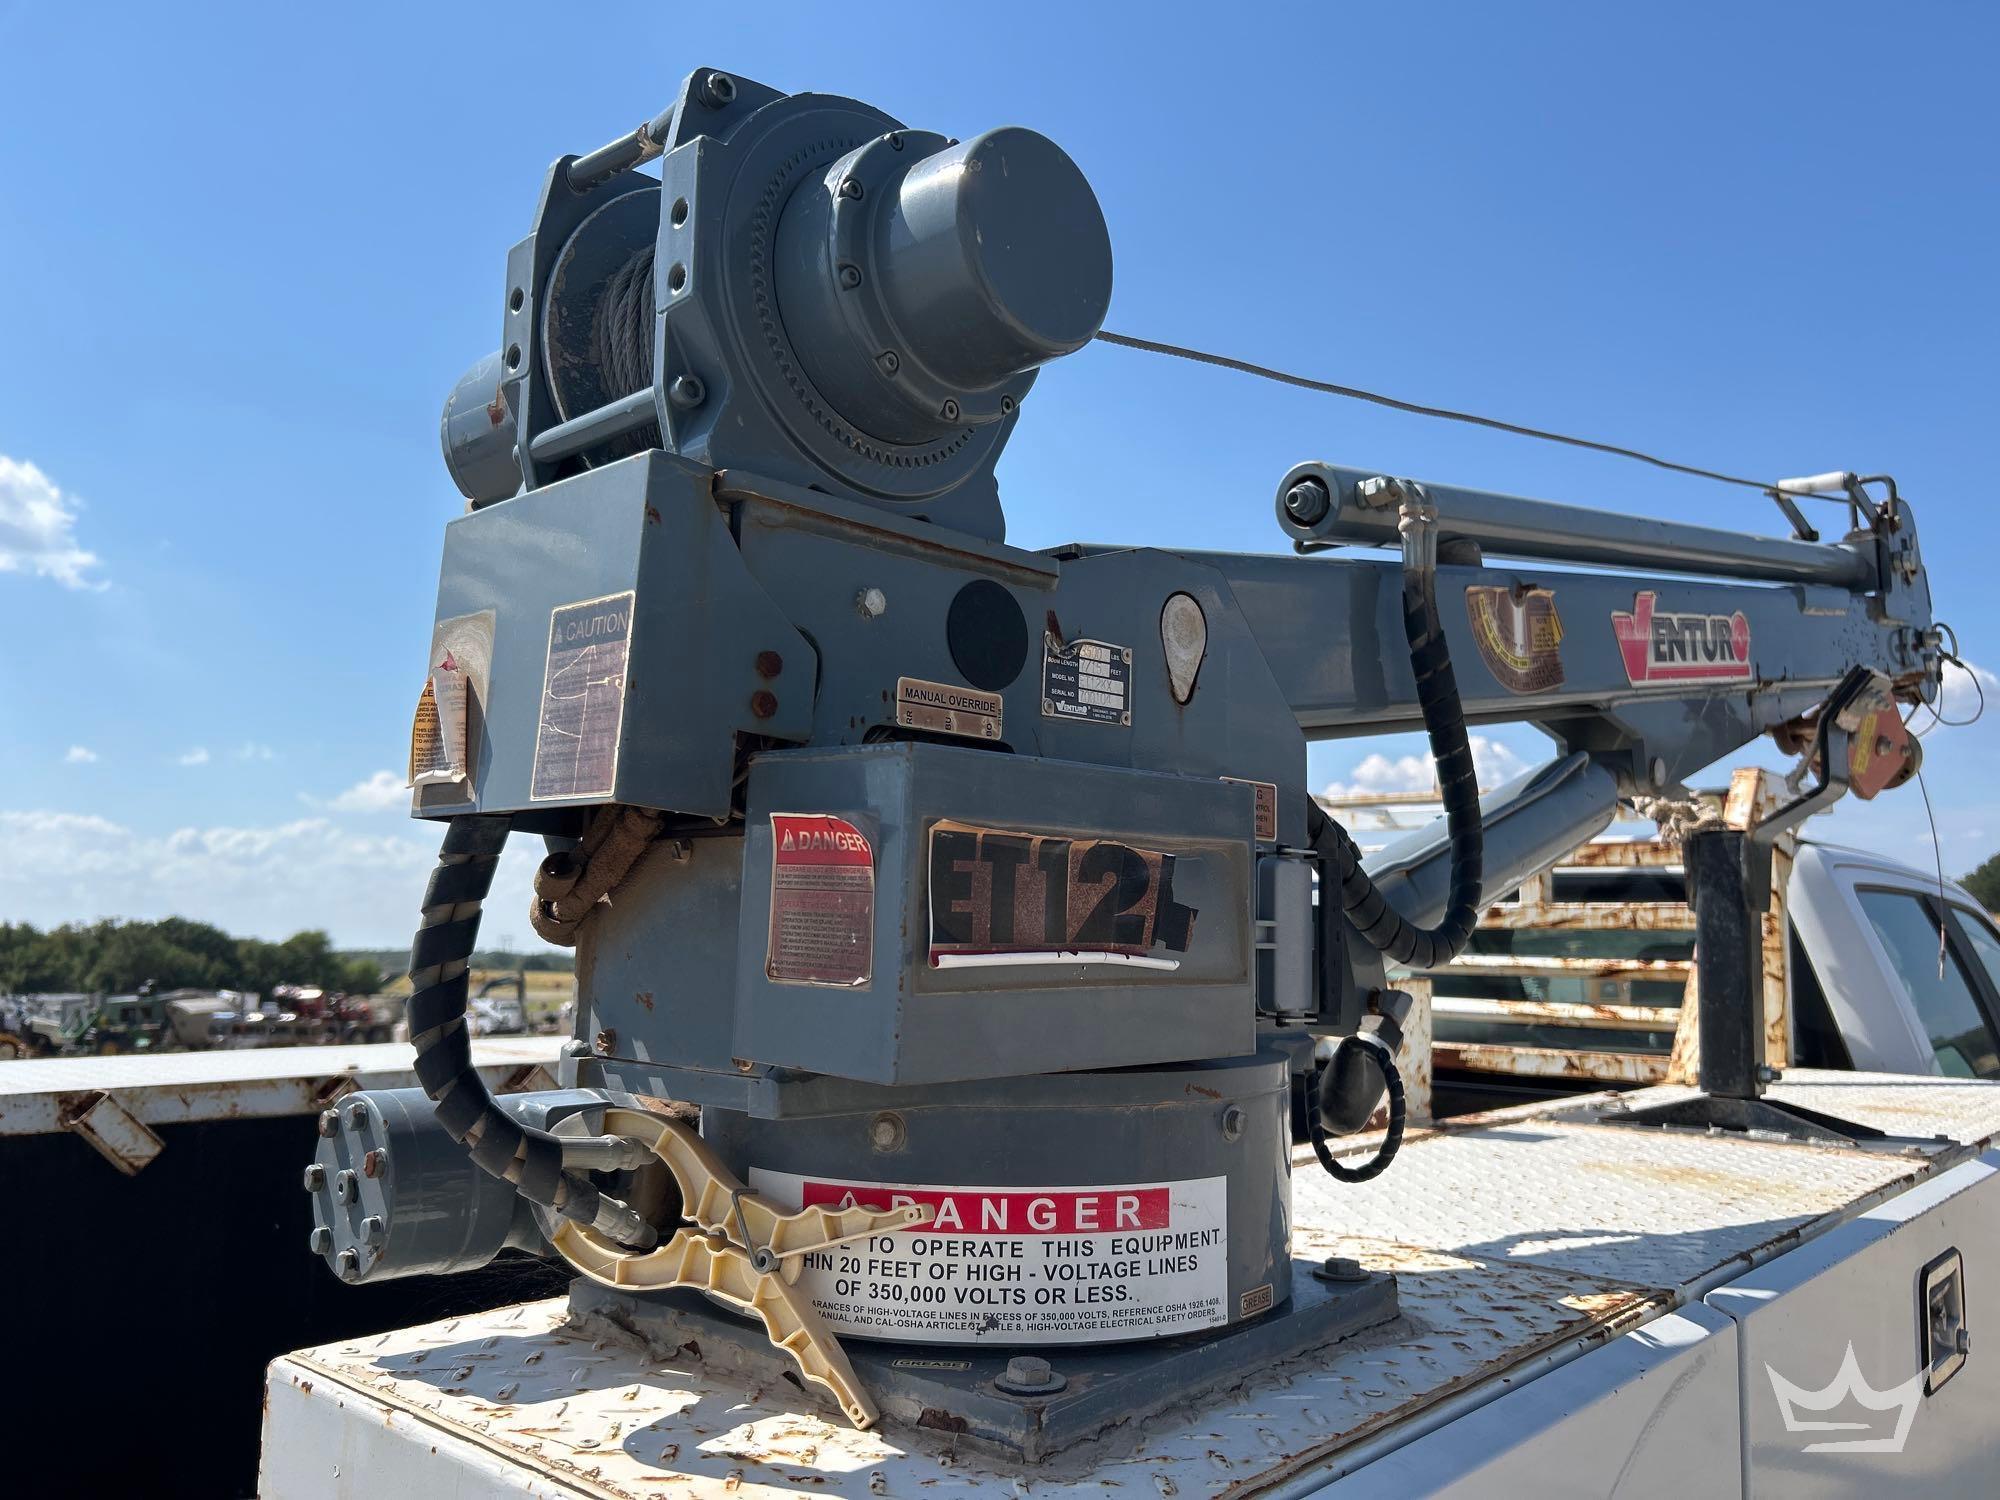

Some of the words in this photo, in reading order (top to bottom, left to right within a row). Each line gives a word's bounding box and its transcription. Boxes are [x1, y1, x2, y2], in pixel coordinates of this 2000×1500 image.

[566, 610, 629, 641] CAUTION
[1612, 590, 1750, 681] VENTURO
[905, 687, 947, 704] MANUAL
[948, 695, 995, 713] OVERRIDE
[798, 831, 868, 852] DANGER
[868, 1236, 895, 1254] TO
[912, 1239, 1023, 1258] OPERATE
[1042, 1240, 1094, 1258] THIS
[1111, 1228, 1220, 1255] EQUIPMENT
[803, 1254, 833, 1271] HIN
[840, 1257, 861, 1274] 20
[869, 1259, 922, 1278] FEET
[929, 1263, 959, 1280] OF
[967, 1264, 1021, 1281] HIGH
[1043, 1261, 1141, 1282] VOLTAGE
[1148, 1255, 1198, 1276] LINES
[835, 1279, 862, 1296] OF
[869, 1282, 946, 1304] 350,000
[954, 1287, 1026, 1305] VOLTS
[1034, 1287, 1066, 1305] OR
[812, 1299, 851, 1313] ARANCES
[853, 1305, 865, 1314] OF
[867, 1307, 937, 1319] HIGH-VOLTAGE
[940, 1311, 968, 1320] LINES
[970, 1312, 980, 1320] IN
[983, 1312, 1022, 1321] EXCESS
[1025, 1312, 1038, 1321] OF
[1041, 1312, 1075, 1322] 350,000
[1112, 1305, 1164, 1318] REFERENCE
[1165, 1303, 1187, 1312] OSHA
[854, 1315, 873, 1324] AND
[875, 1317, 924, 1328] CAL-OSHA
[926, 1320, 968, 1330] ARTICLE
[1016, 1322, 1025, 1332] 8,
[1027, 1321, 1098, 1331] HIGH-VOLTAGE
[1100, 1316, 1153, 1329] ELECTRICAL
[1155, 1313, 1185, 1323] SAFETY
